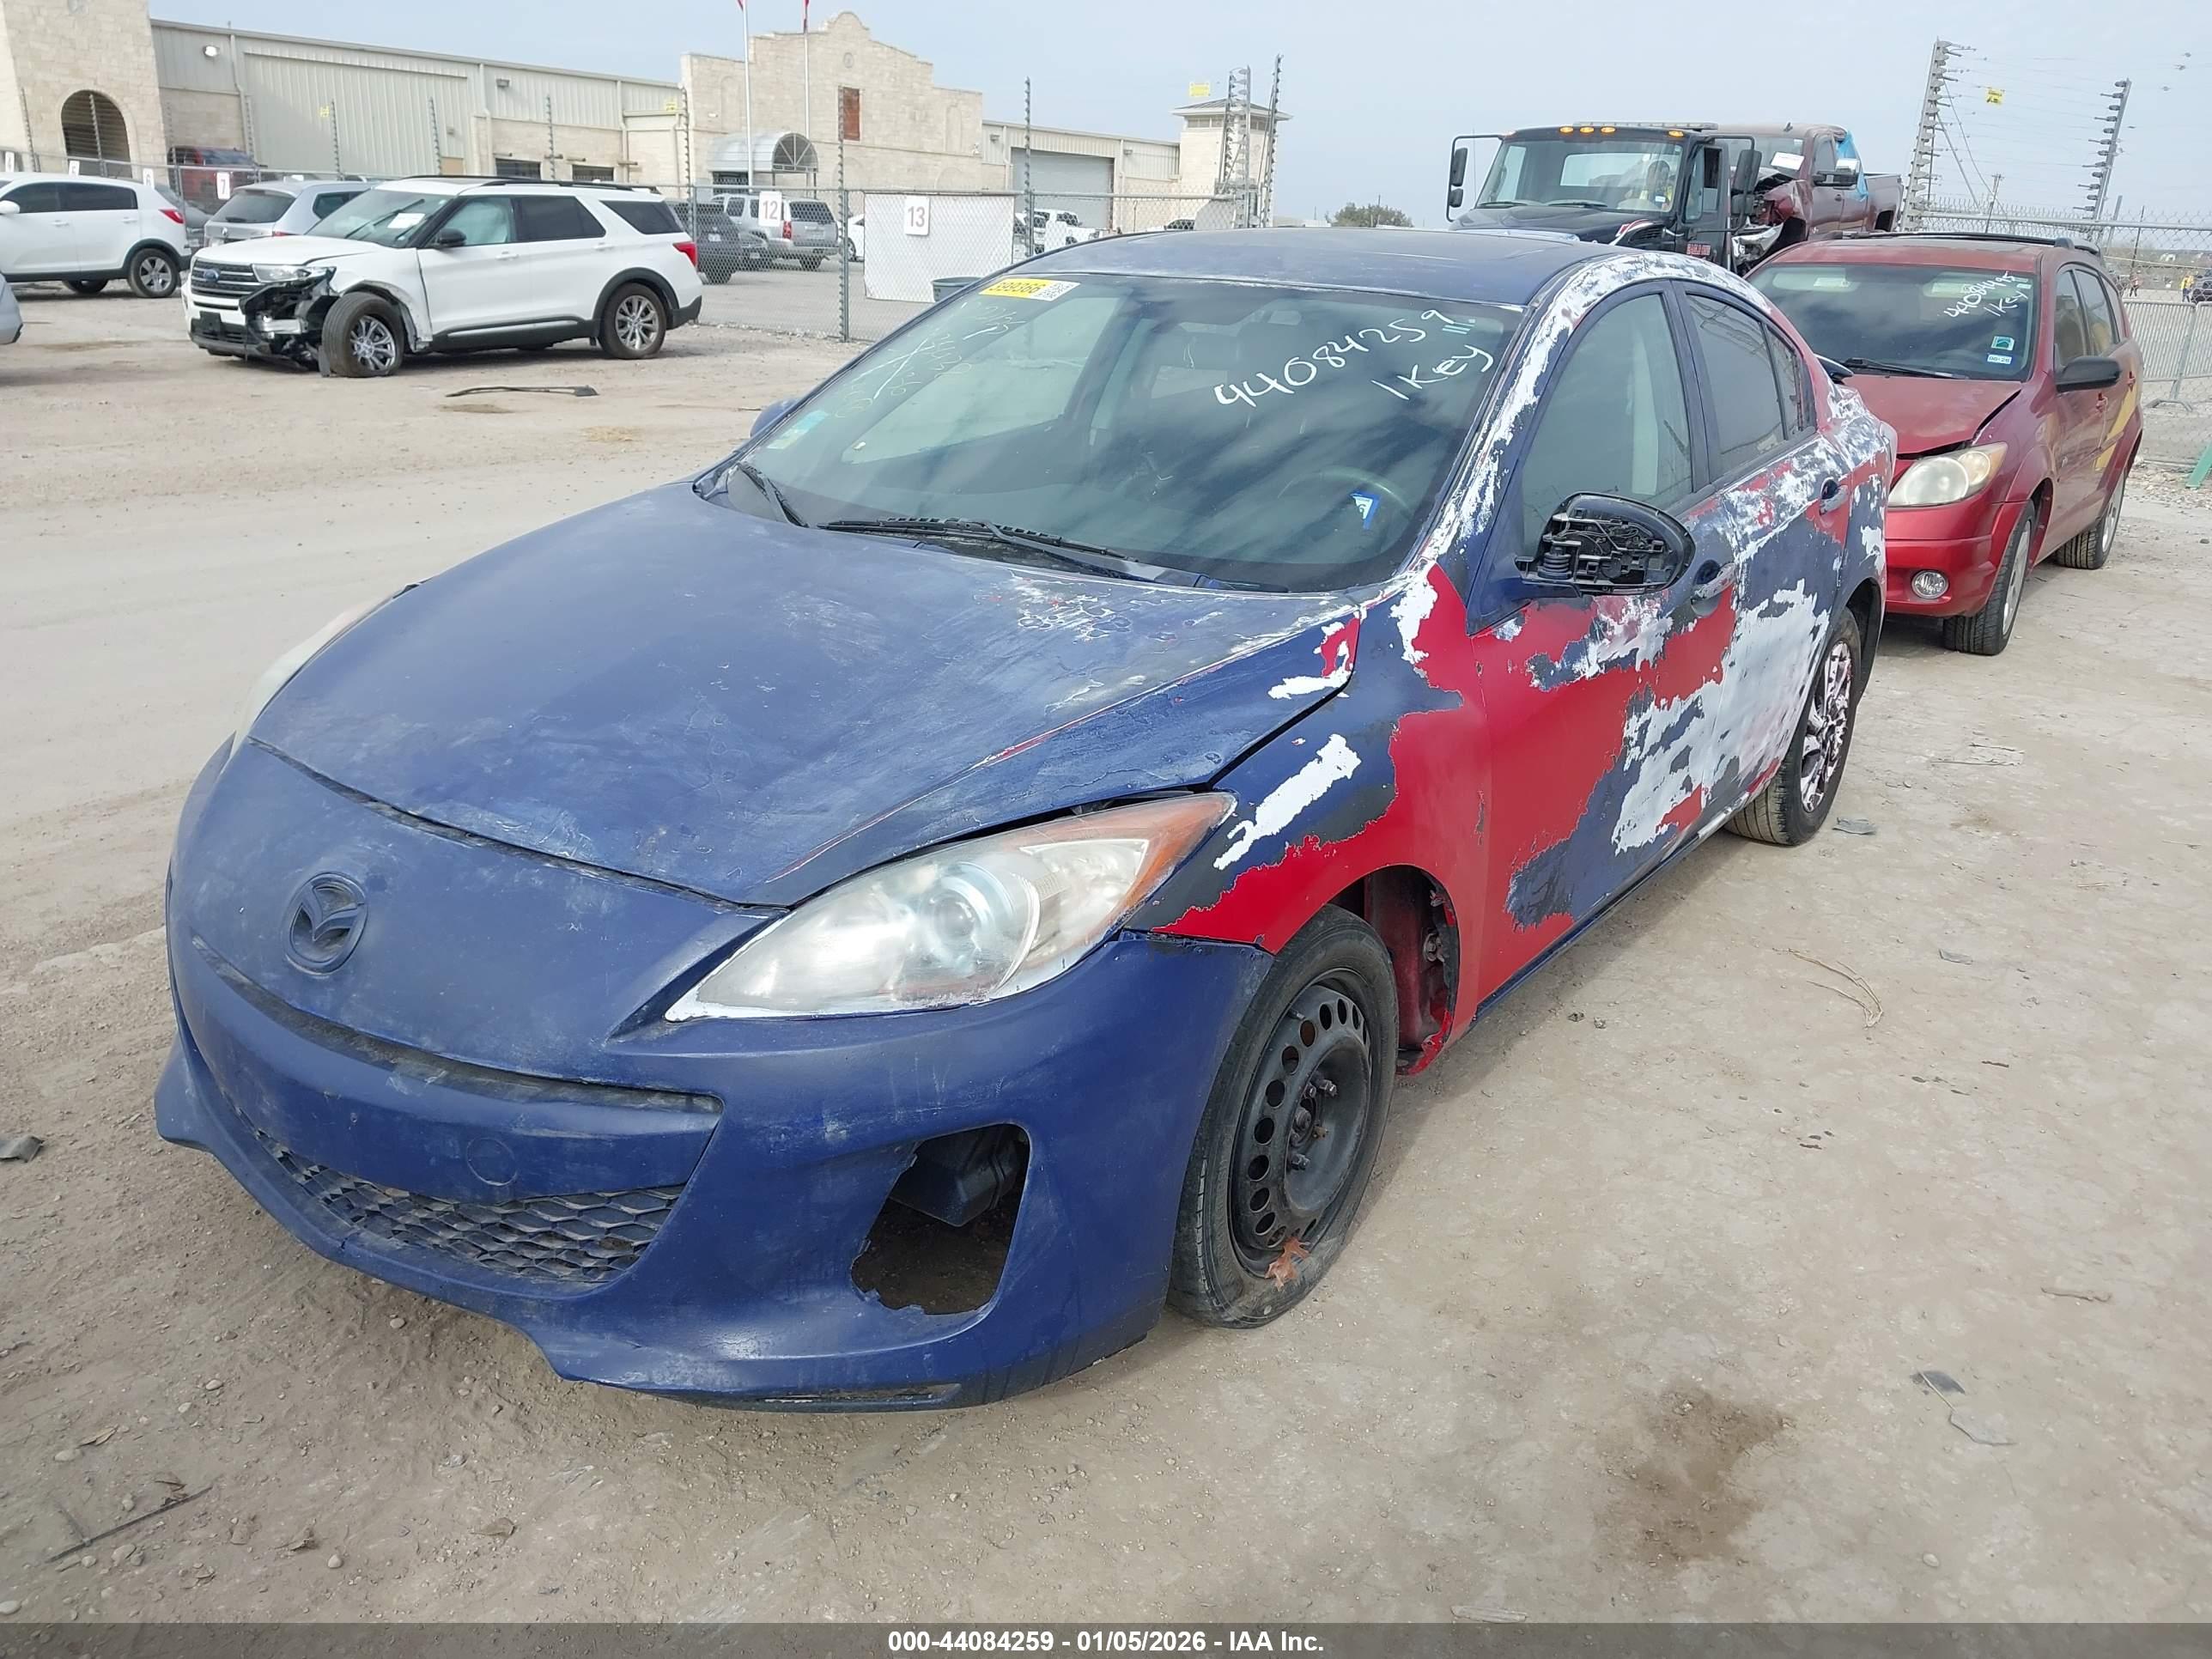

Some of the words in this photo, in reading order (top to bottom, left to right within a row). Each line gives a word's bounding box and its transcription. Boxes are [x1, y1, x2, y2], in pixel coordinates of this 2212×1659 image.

[762, 200, 779, 220] 12
[907, 205, 926, 228] 13
[1943, 271, 2015, 318] 44084495
[1213, 309, 1455, 407] 44084259
